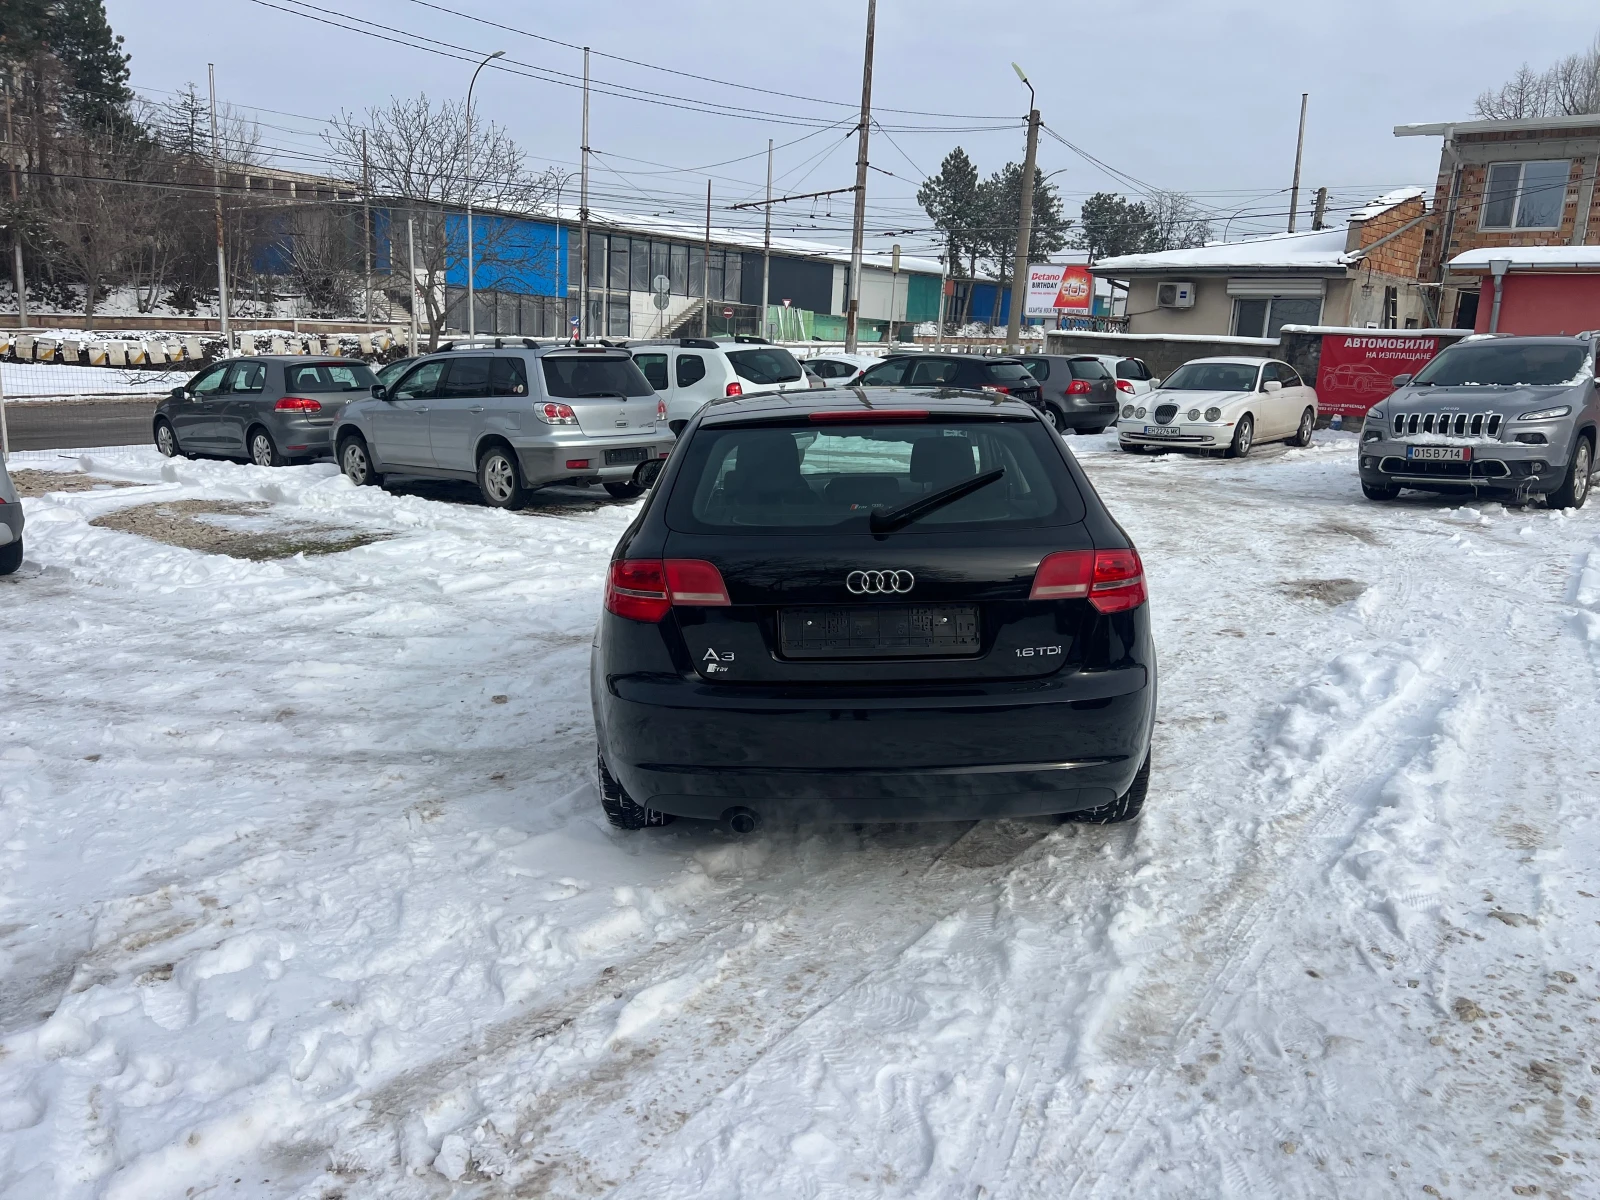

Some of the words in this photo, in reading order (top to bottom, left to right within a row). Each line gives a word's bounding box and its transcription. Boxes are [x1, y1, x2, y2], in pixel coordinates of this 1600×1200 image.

[1031, 273, 1060, 281] Betano
[1344, 338, 1435, 350] АВТОМОБИЛИ
[1365, 351, 1377, 359] НА
[1378, 352, 1432, 361] ИЗПЛАЩАНЕ
[702, 647, 735, 661] A3
